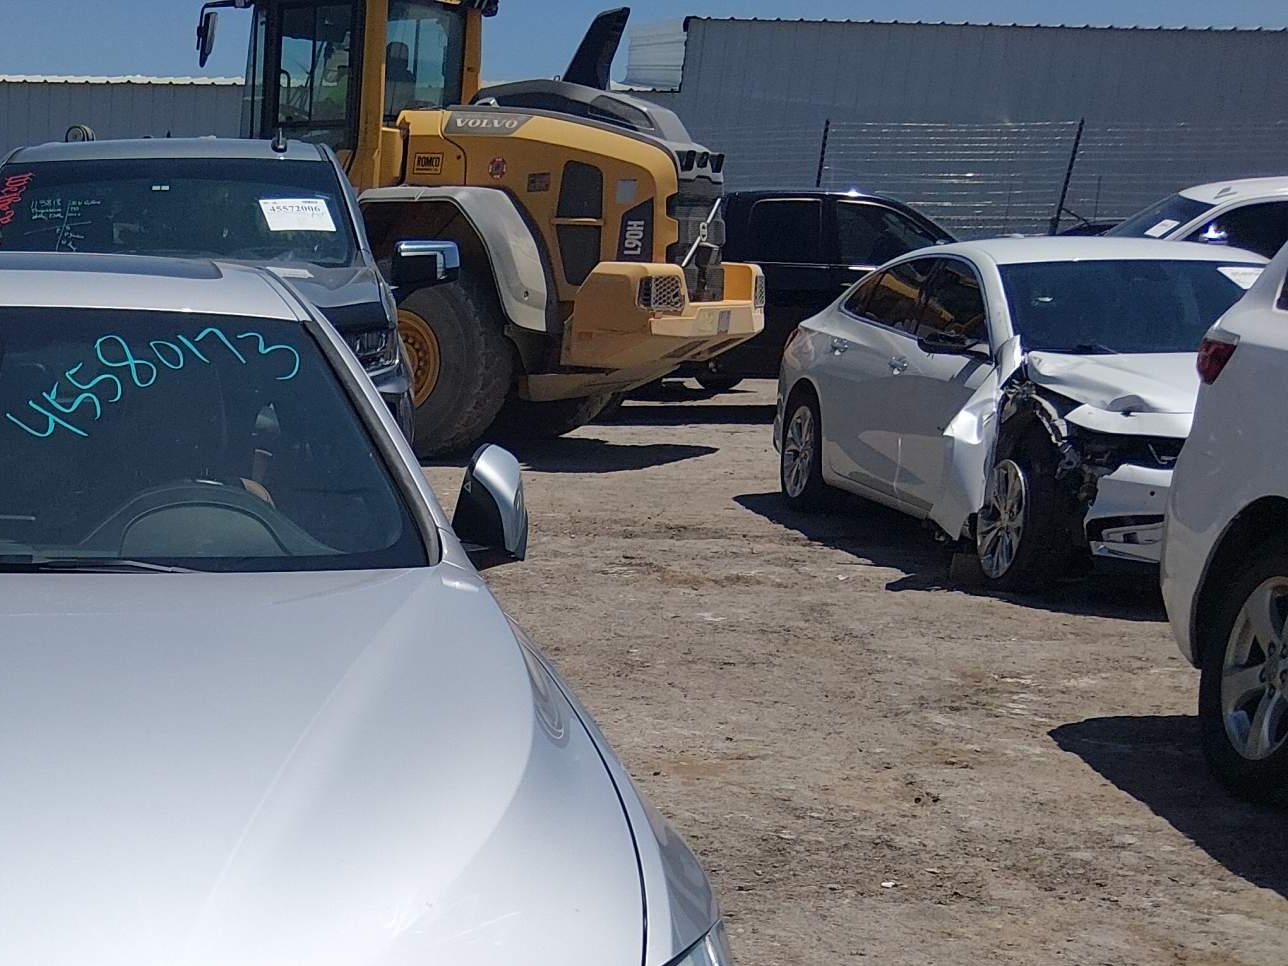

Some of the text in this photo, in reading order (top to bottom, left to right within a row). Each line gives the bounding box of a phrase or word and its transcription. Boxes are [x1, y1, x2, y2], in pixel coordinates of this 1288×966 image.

[456, 118, 518, 129] VOLVO
[623, 220, 645, 255] L90H
[6, 327, 300, 437] 45580173
